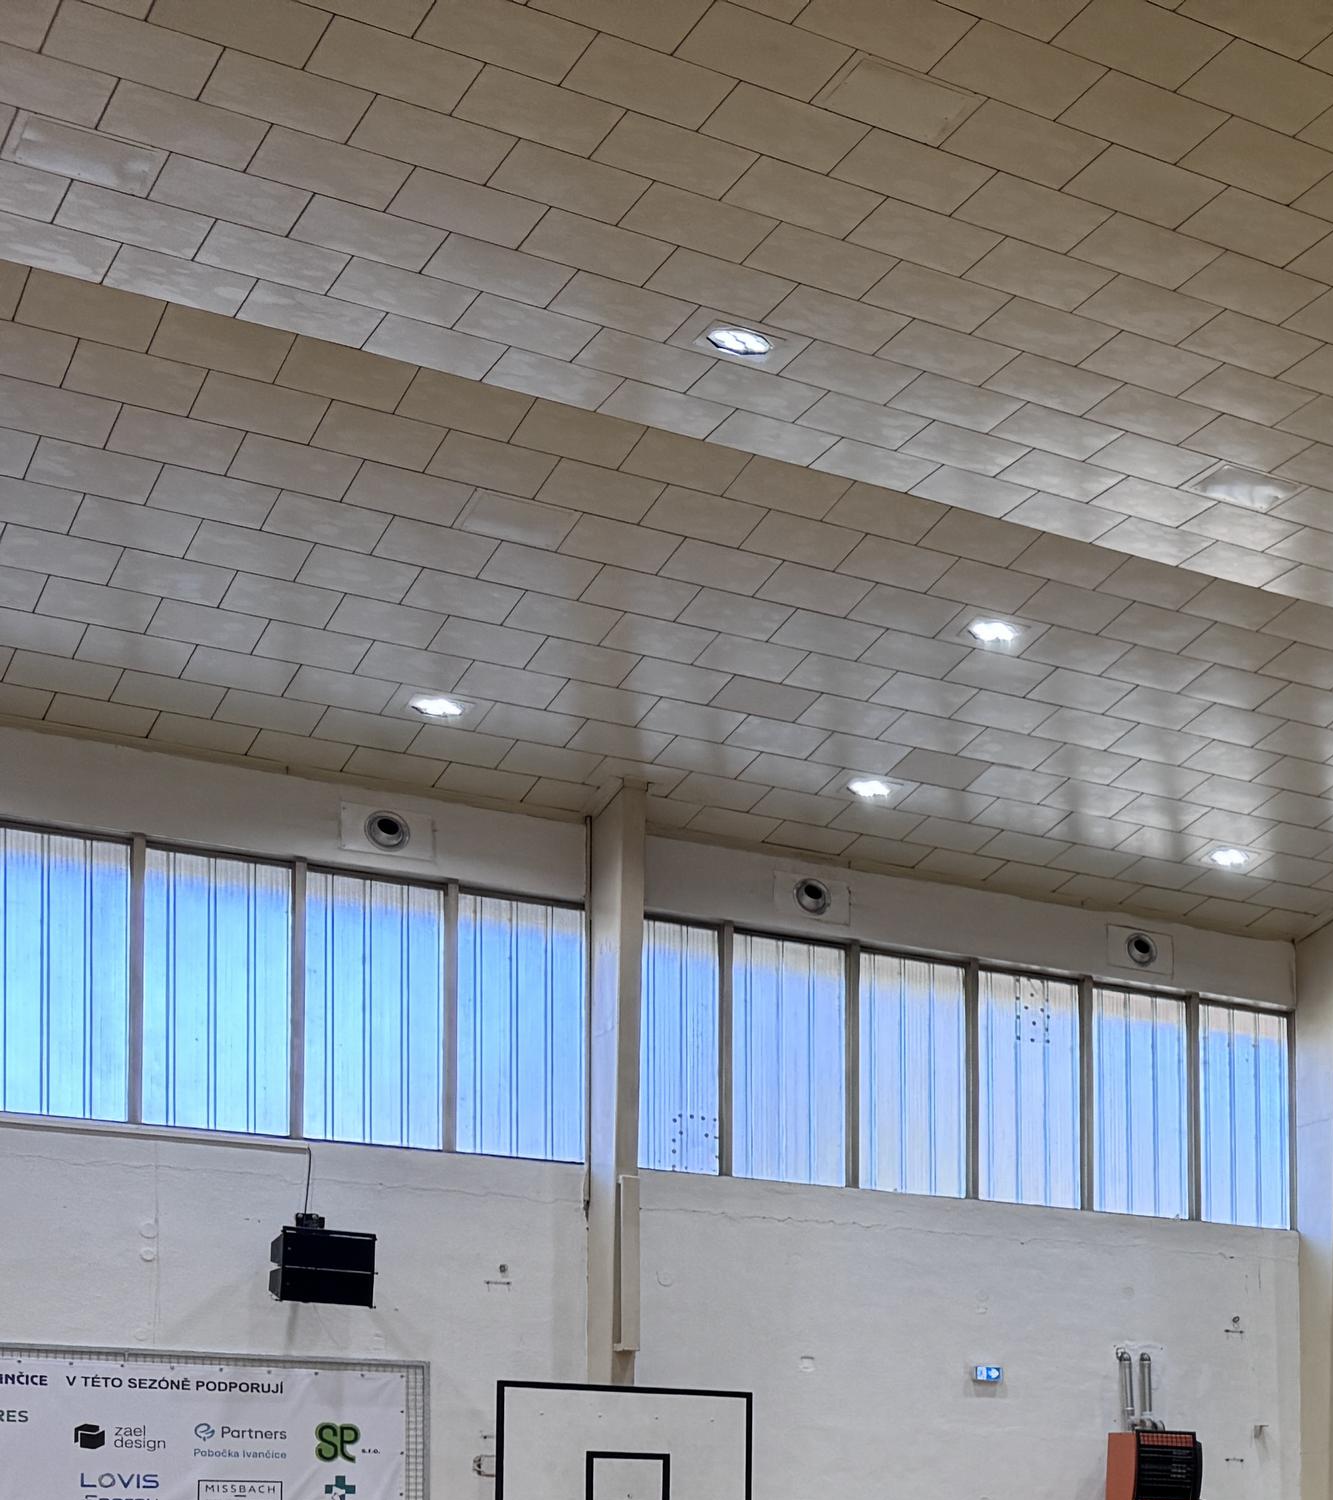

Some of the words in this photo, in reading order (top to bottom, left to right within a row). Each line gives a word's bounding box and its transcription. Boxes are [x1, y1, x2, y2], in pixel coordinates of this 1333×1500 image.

[66, 1376, 76, 1387] V
[81, 1375, 123, 1388] TÉTO
[128, 1377, 191, 1391] SEZÓNĚ
[195, 1380, 284, 1394] PODPORUJÍ
[114, 1425, 147, 1437] zael
[221, 1427, 287, 1440] Partners
[114, 1437, 166, 1452] design
[193, 1448, 239, 1458] Pobočka
[80, 1473, 160, 1489] LOVIS
[205, 1484, 276, 1494] MISSBACH
